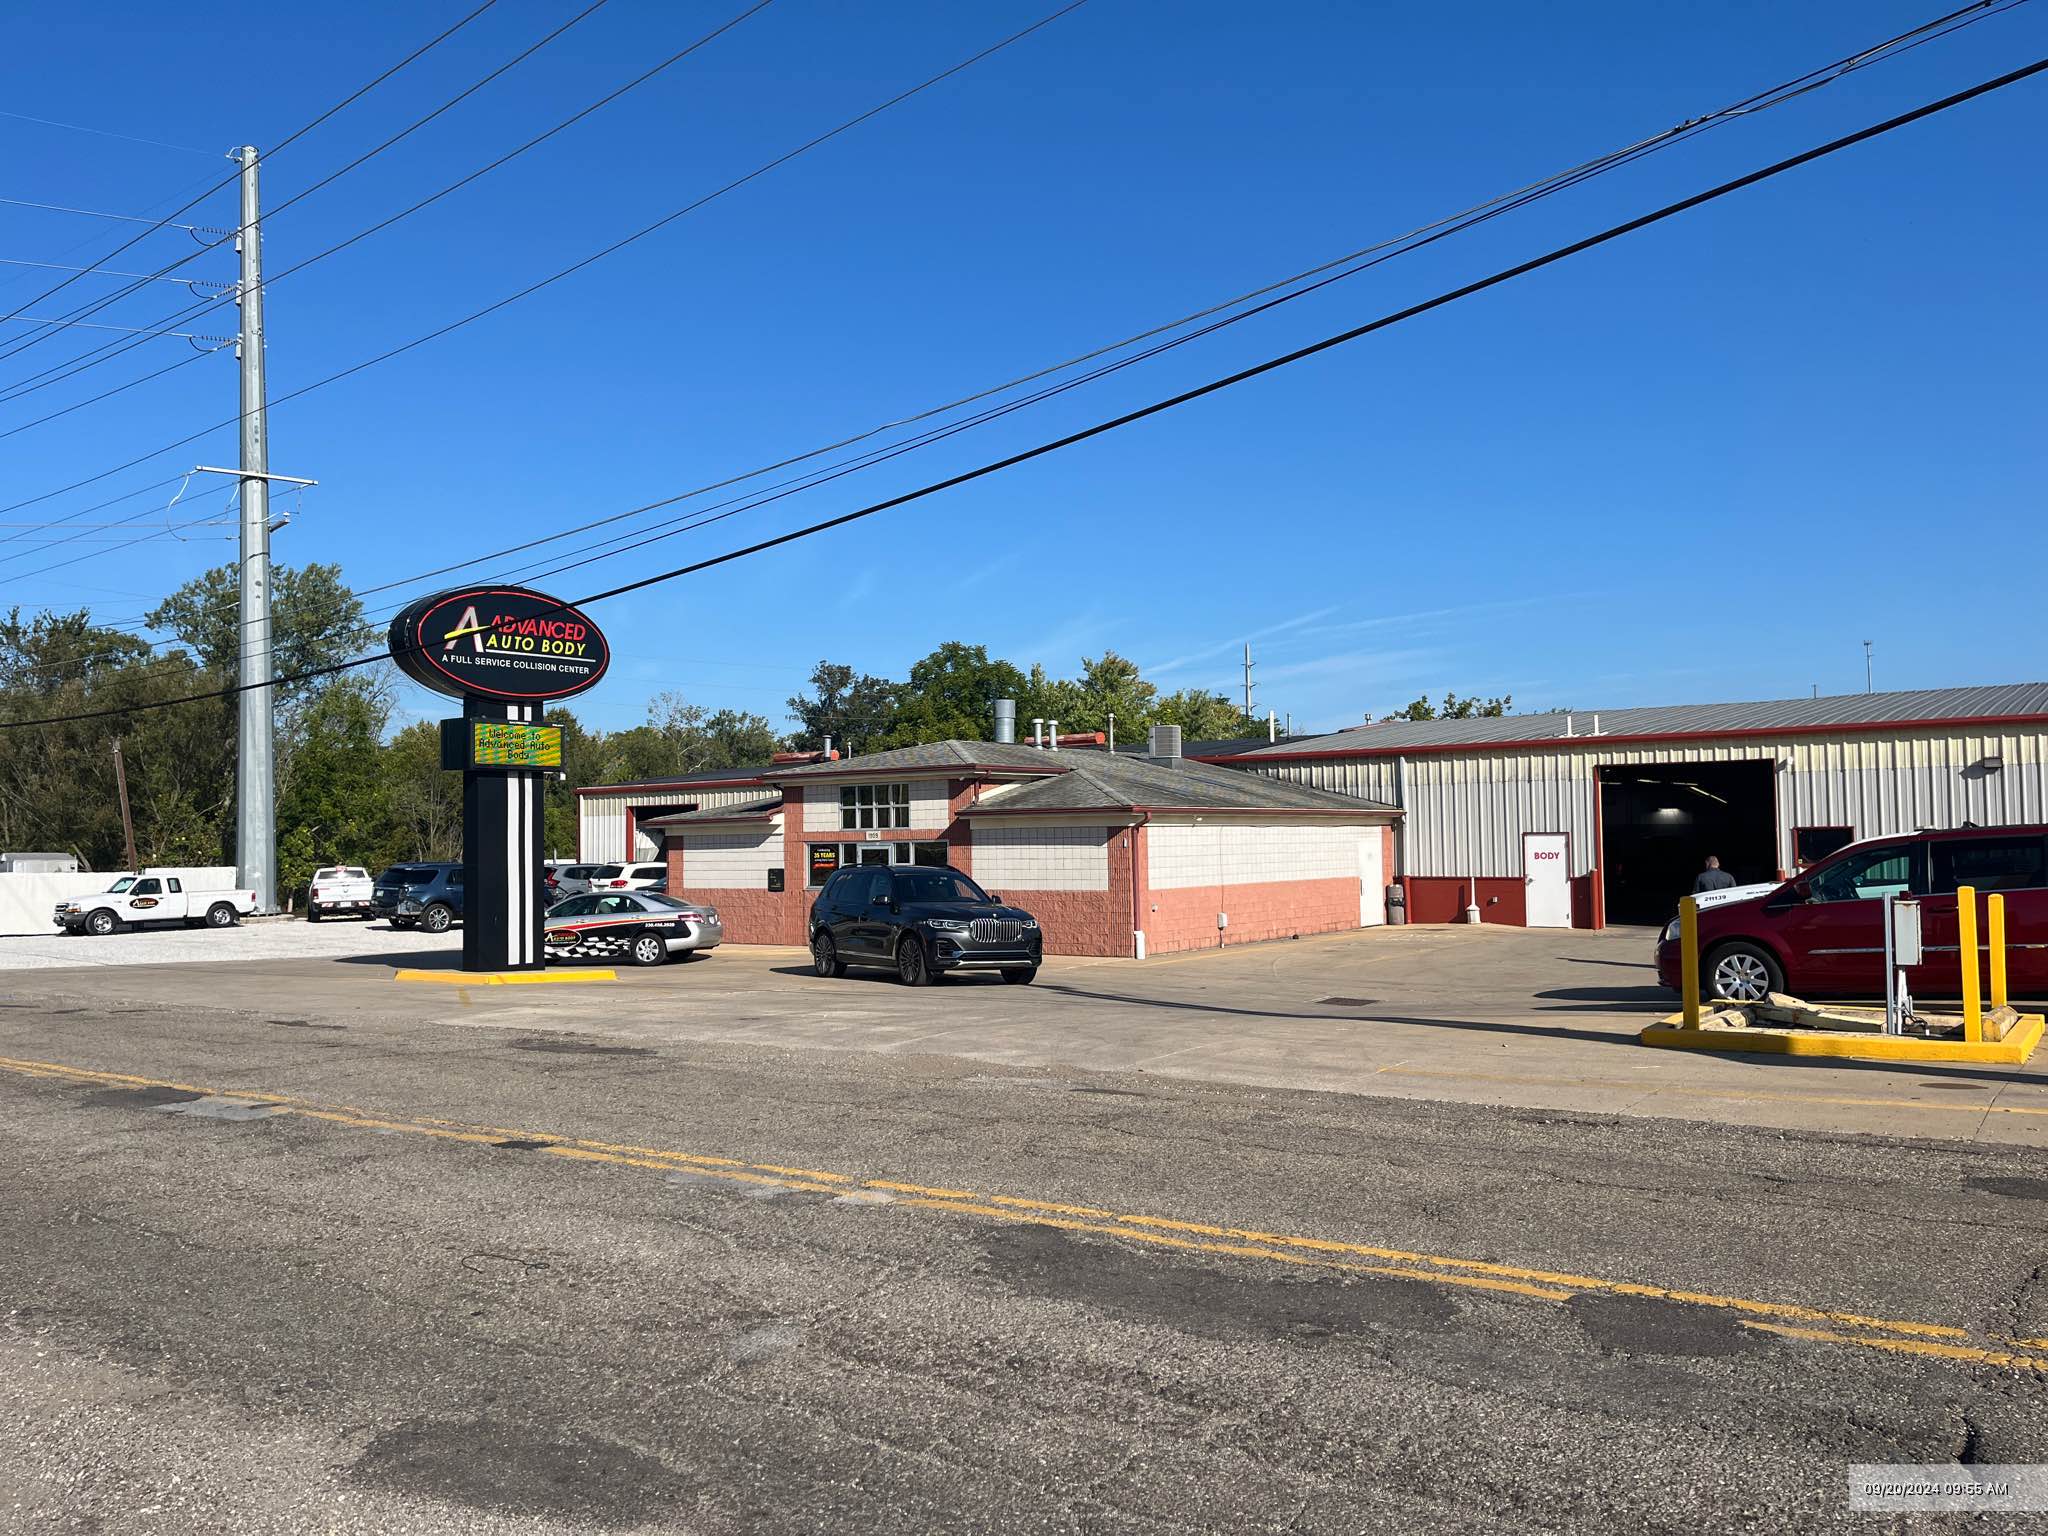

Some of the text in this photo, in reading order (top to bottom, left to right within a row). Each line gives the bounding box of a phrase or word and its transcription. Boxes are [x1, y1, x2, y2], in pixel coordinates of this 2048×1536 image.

[491, 615, 587, 641] ADVANCED
[486, 634, 586, 656] AUTO BODY
[442, 654, 590, 674] A FULL SERVICE COLLISION CENTER
[488, 729, 527, 740] Welcome
[478, 738, 551, 751] Advanced Auto
[507, 749, 530, 760] Body
[1534, 852, 1560, 860] BODY
